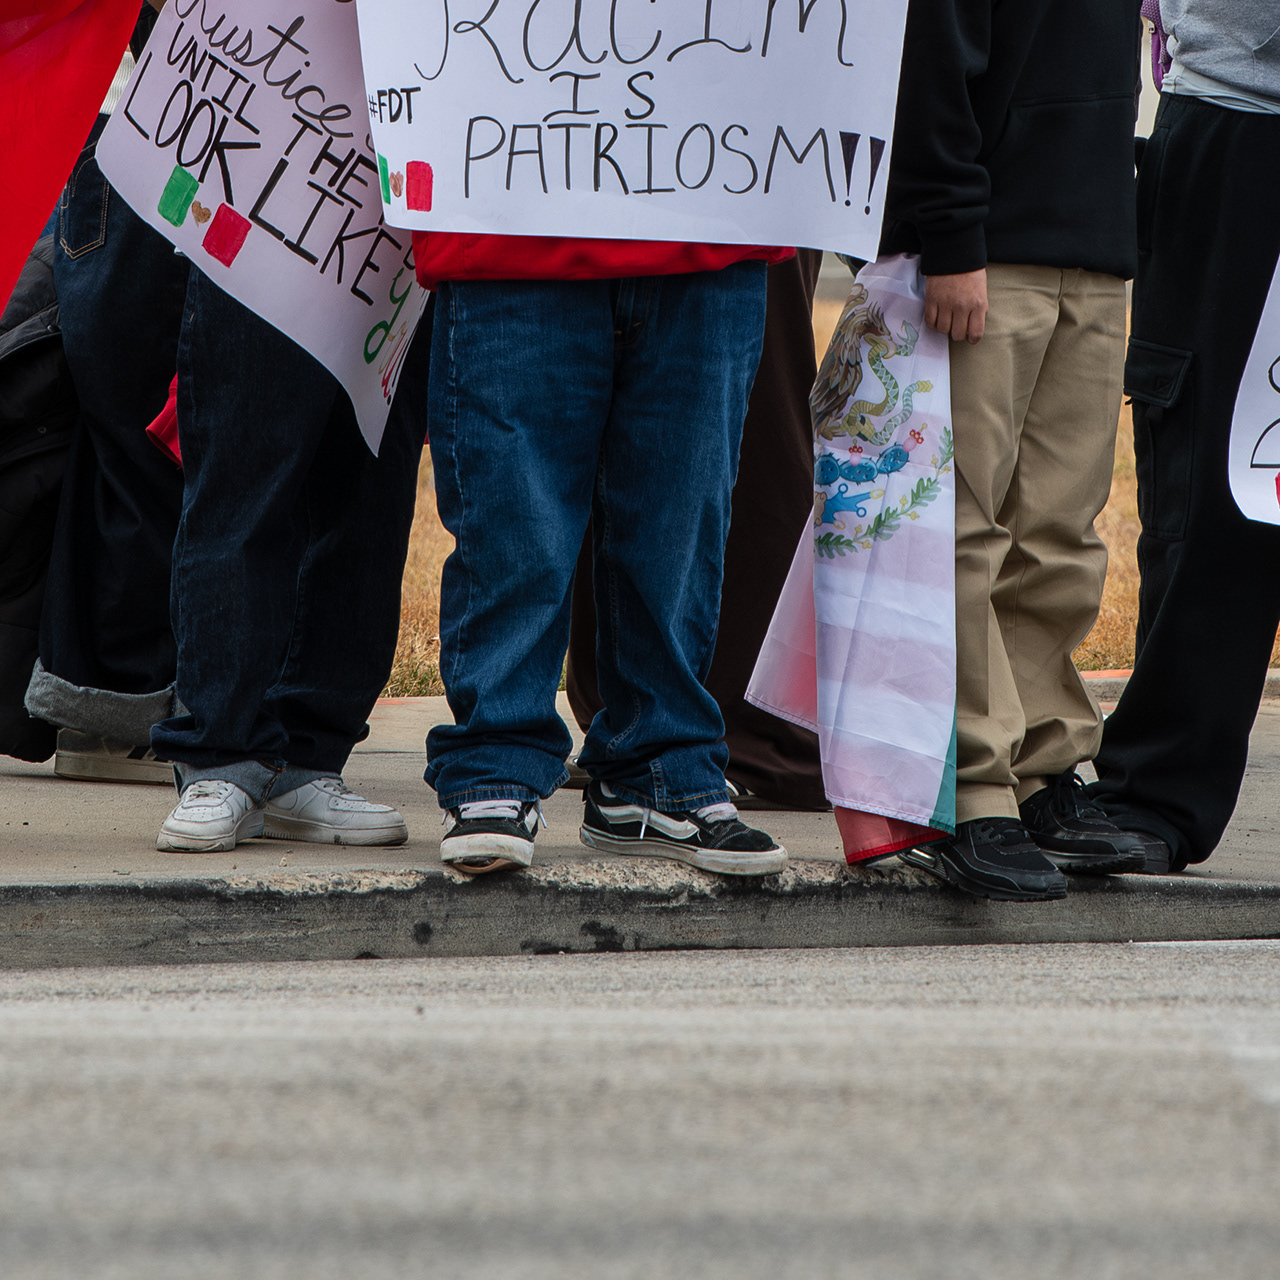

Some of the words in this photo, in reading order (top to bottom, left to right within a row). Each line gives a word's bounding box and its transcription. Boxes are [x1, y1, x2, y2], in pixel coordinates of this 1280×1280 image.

[167, 21, 260, 135] UNTIL
[284, 112, 380, 210] THE
[367, 86, 422, 125] #FDT
[542, 70, 656, 122] IS
[124, 51, 262, 207] LOOK
[247, 156, 404, 307] LIKE
[464, 115, 886, 216] PATRIOSM!!
